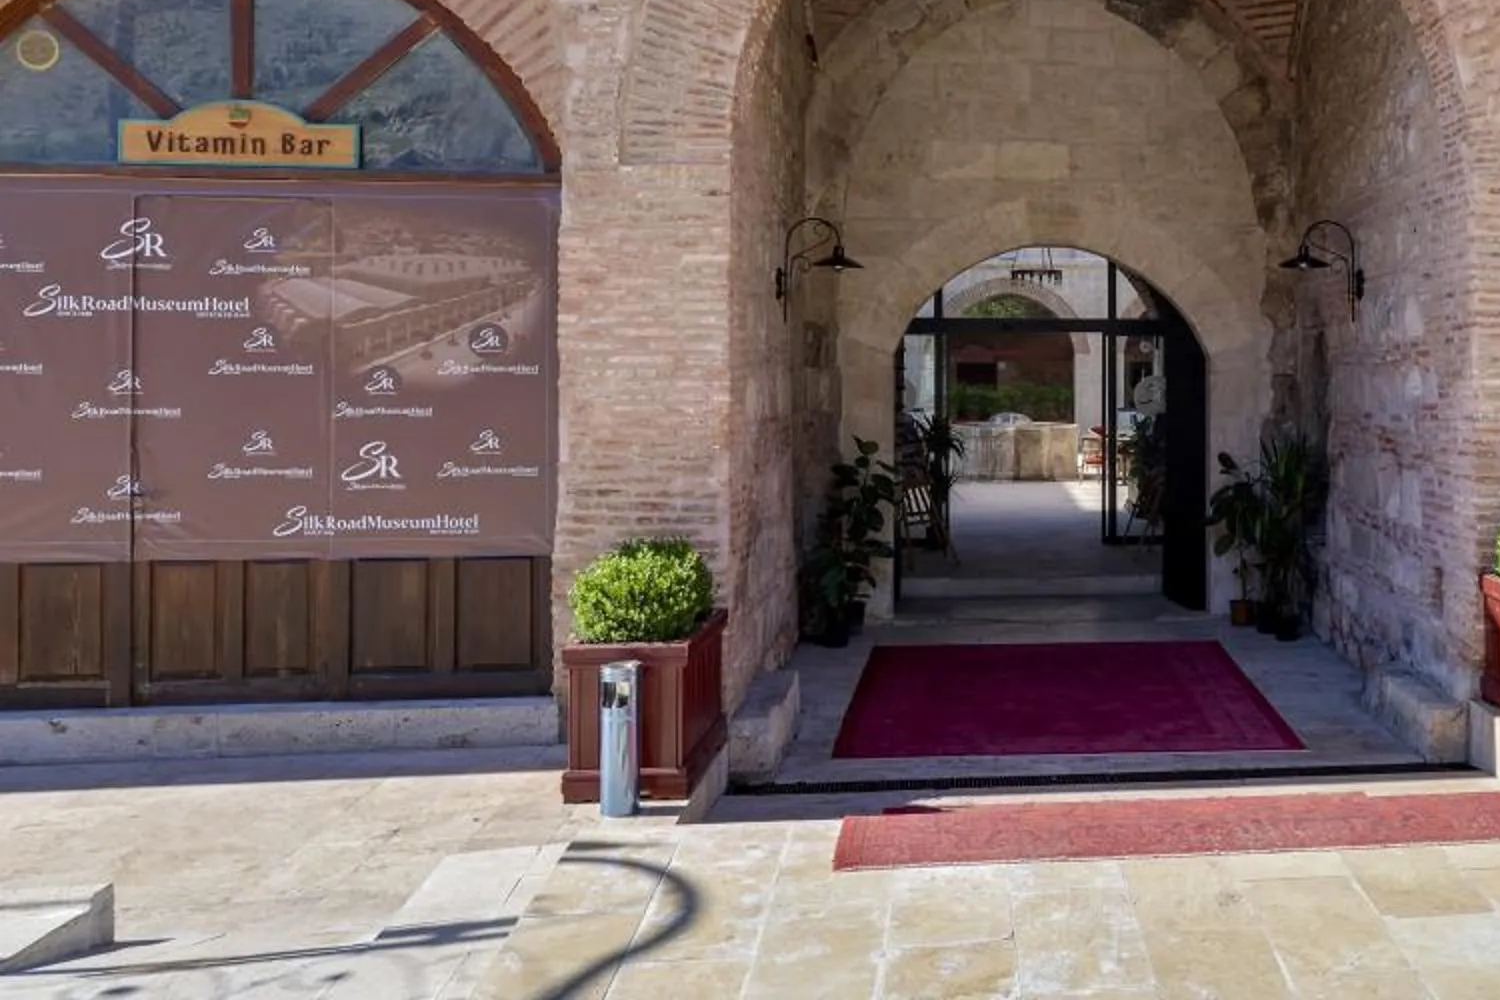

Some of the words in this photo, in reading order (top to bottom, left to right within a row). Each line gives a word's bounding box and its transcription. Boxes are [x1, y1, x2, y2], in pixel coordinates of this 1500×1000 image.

[147, 130, 266, 155] Vitamin
[281, 133, 331, 155] Bar
[341, 441, 402, 481] SR
[273, 505, 480, 537] SilkRoadMuseumHotel
